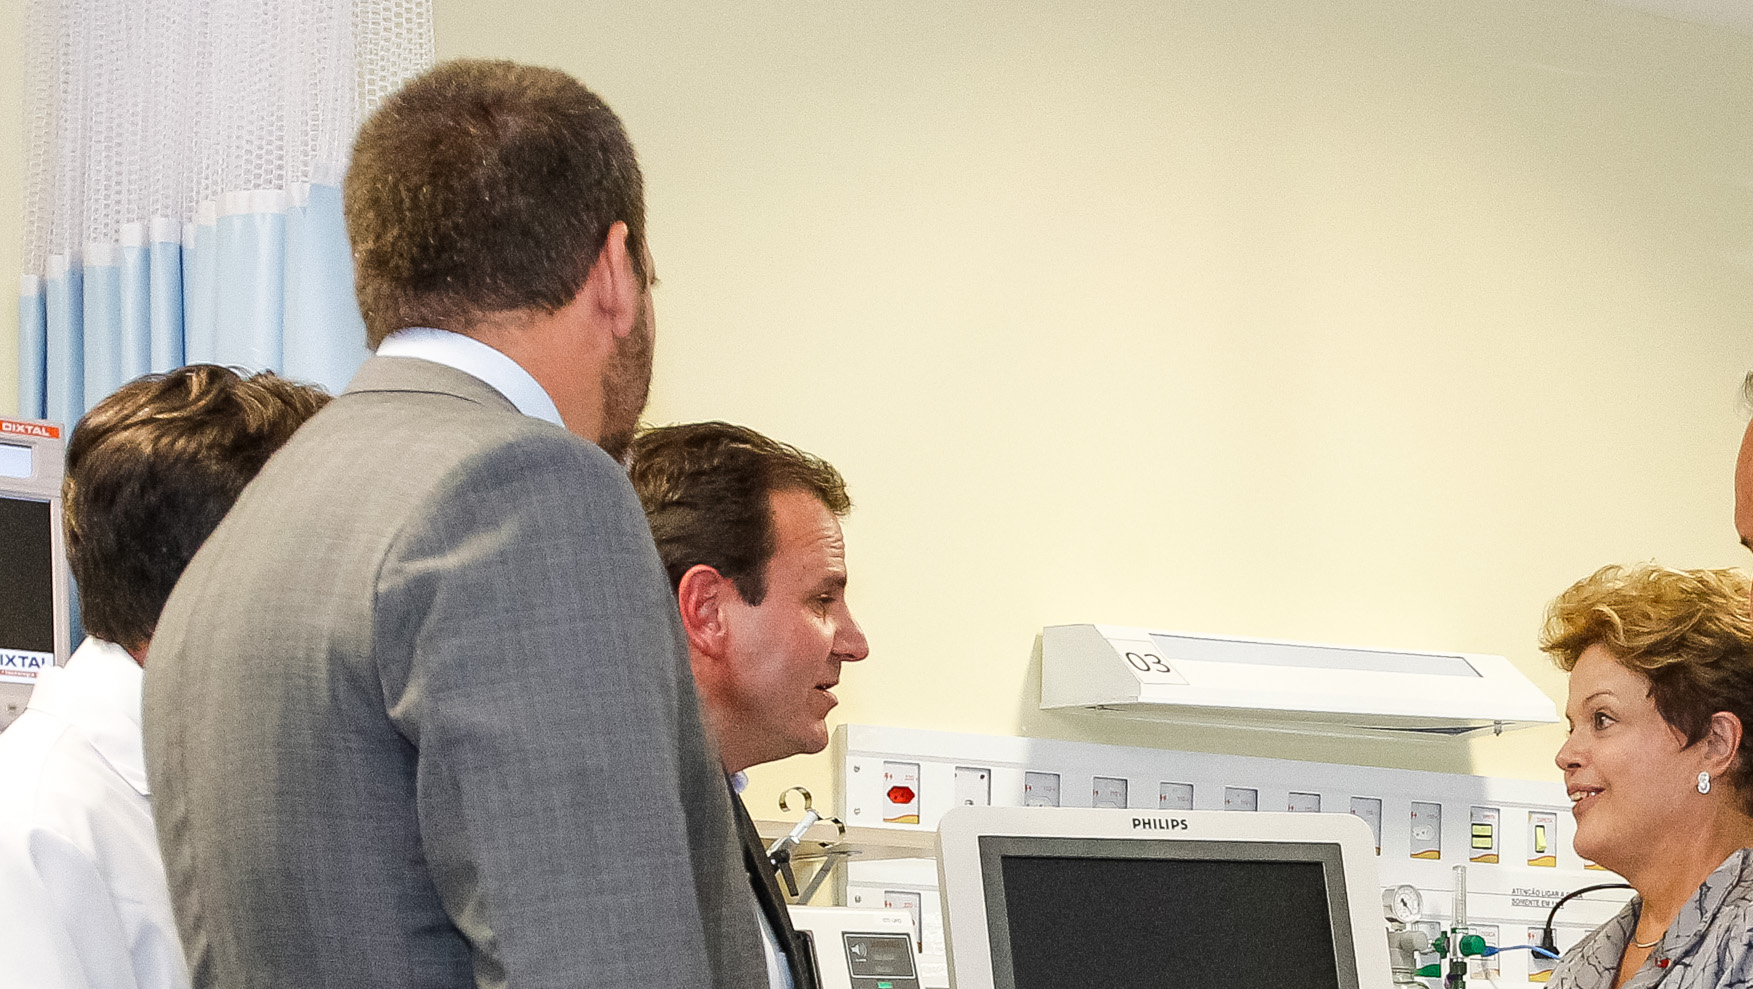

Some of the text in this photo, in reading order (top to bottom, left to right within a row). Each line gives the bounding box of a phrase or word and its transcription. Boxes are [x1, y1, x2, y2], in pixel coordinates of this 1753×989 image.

[2, 422, 49, 436] DIXTAL
[0, 654, 45, 668] IXTA
[1125, 652, 1170, 673] 03
[1132, 818, 1188, 830] PHILIPS
